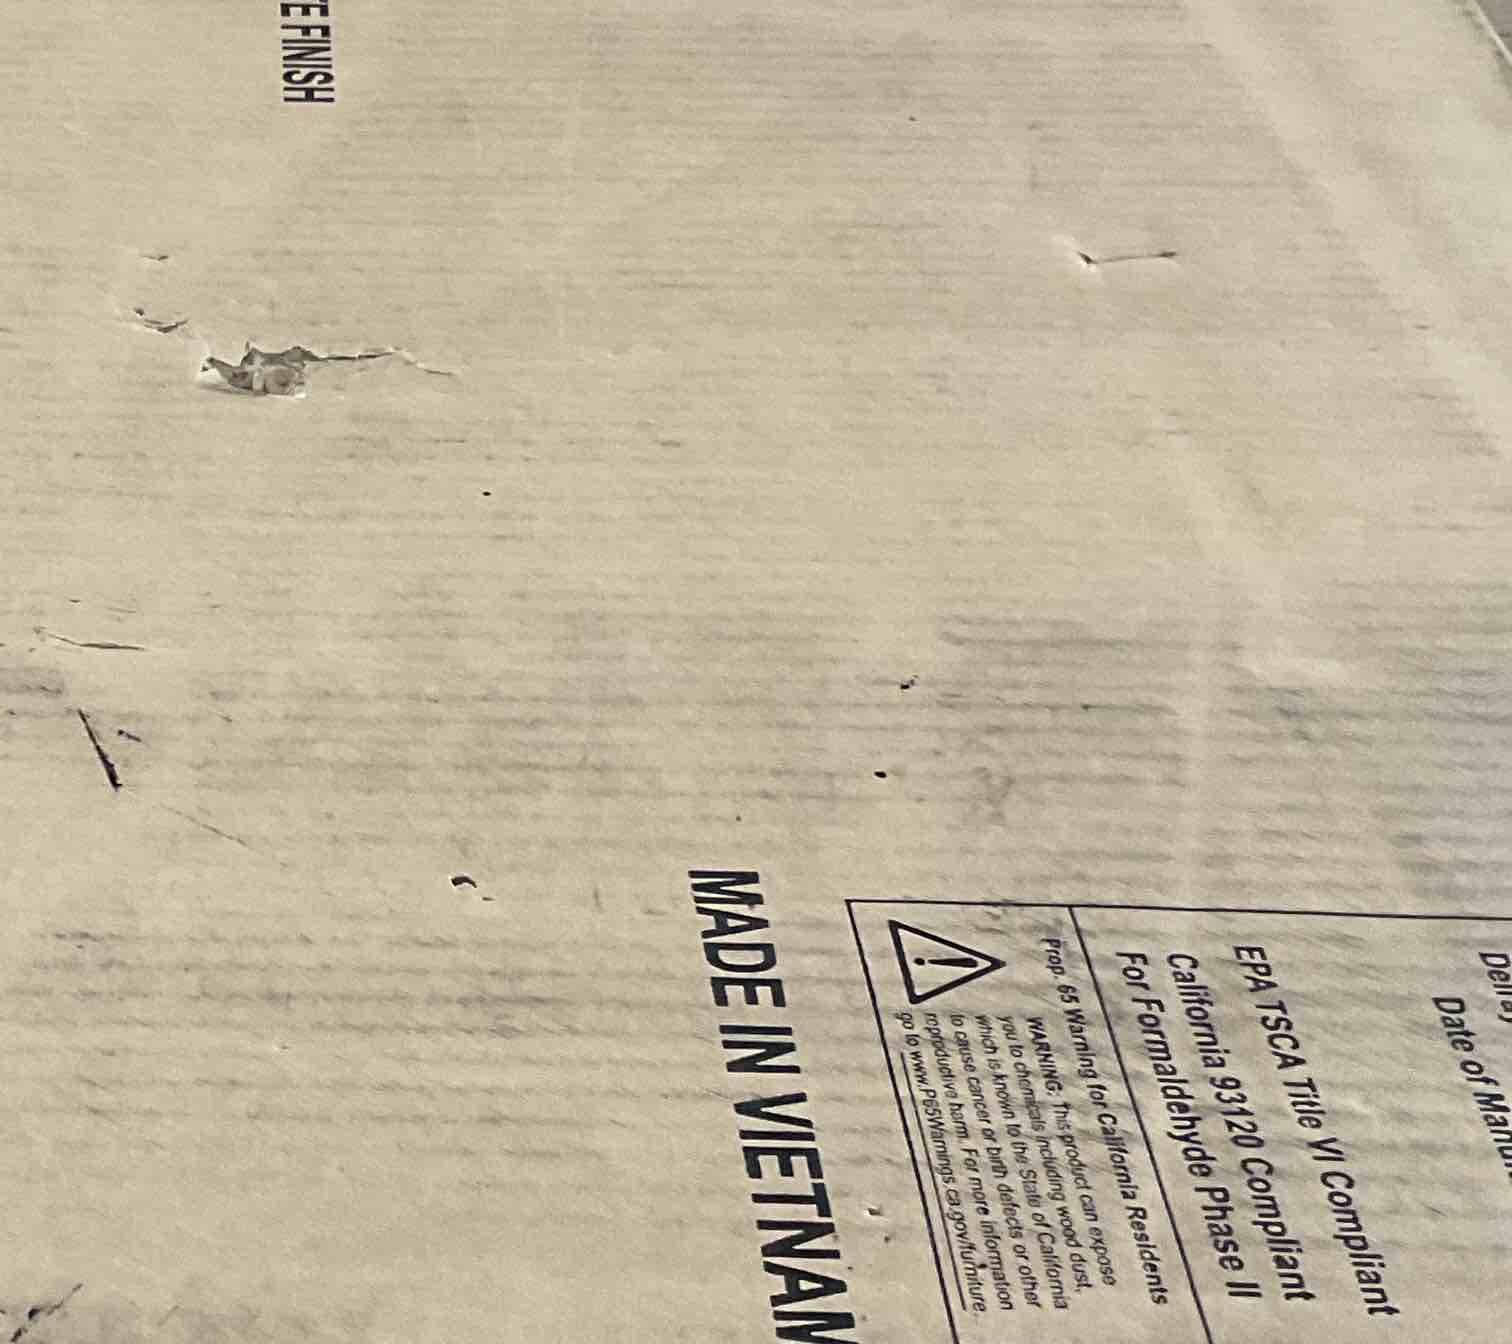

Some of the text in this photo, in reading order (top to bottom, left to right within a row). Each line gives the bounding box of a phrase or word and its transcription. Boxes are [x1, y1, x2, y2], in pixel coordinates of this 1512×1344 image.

[281, 24, 335, 103] FINISH
[688, 869, 786, 1007] MADE
[894, 1011, 915, 1031] go
[1055, 984, 1081, 1004] 65
[720, 1024, 800, 1074] IN
[904, 1033, 921, 1047] to
[923, 1012, 959, 1099] reproductive
[997, 1015, 1019, 1041] you
[1007, 1044, 1025, 1058] to
[1063, 1008, 1100, 1080] Warning
[1432, 995, 1476, 1053] Date
[1459, 1059, 1499, 1087] of
[1013, 1061, 1047, 1132] chemicals
[1050, 1101, 1072, 1131] This
[1086, 1083, 1110, 1110] for
[1115, 950, 1263, 1299] For Formaldehyde Phase II
[1166, 952, 1317, 1302] California 93120 Compliant
[948, 1013, 1043, 1309] to cause cancer or birth defects or other
[960, 1148, 980, 1173] For
[974, 1014, 1069, 1310] which is known to the State of California
[1056, 1133, 1093, 1191] product
[1096, 1112, 1140, 1201] California
[1233, 945, 1401, 1318] EPA TSCA Title VI Compliant
[967, 1176, 990, 1216] more
[1035, 1135, 1066, 1202] including
[1055, 1205, 1084, 1248] wood
[1078, 1193, 1099, 1223] can
[979, 1220, 1015, 1311] information
[1088, 1226, 1118, 1287] expose
[1124, 1205, 1169, 1305] Residents
